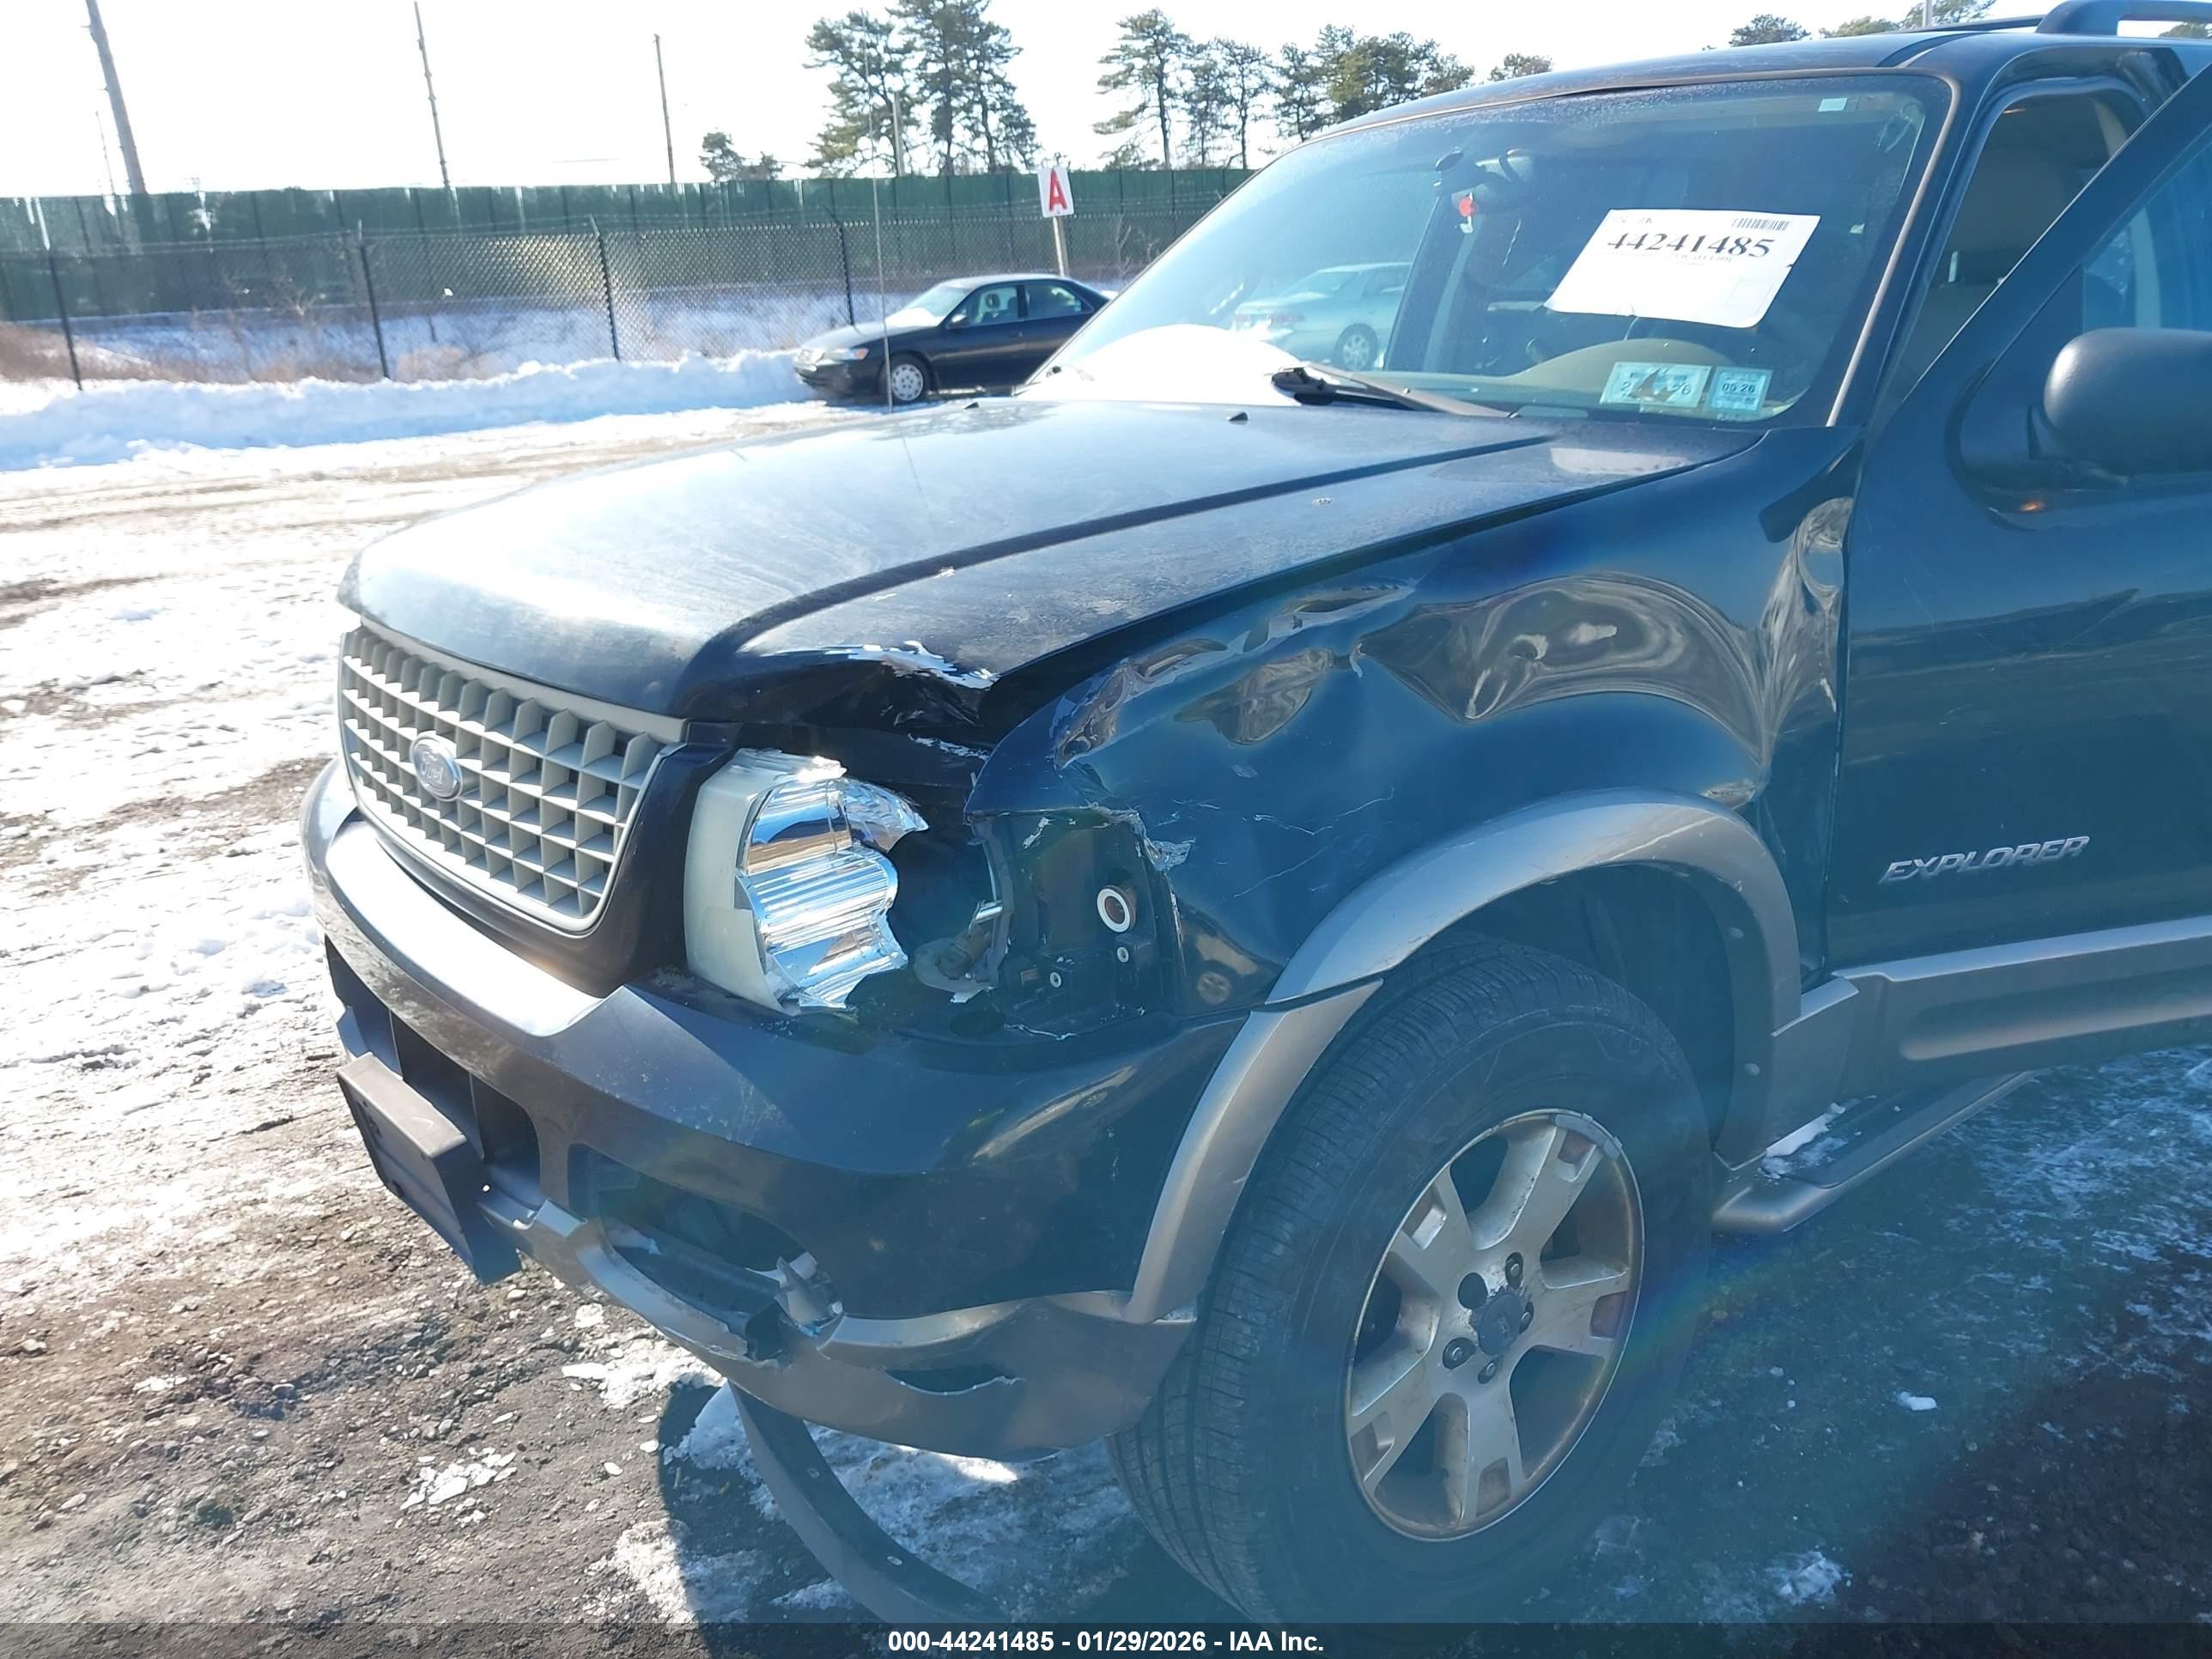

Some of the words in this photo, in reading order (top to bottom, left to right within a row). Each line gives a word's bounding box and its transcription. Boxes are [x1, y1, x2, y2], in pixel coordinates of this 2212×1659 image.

[1048, 168, 1067, 211] A
[1607, 233, 1776, 258] 44241485
[1879, 836, 2090, 884] EXPLORER
